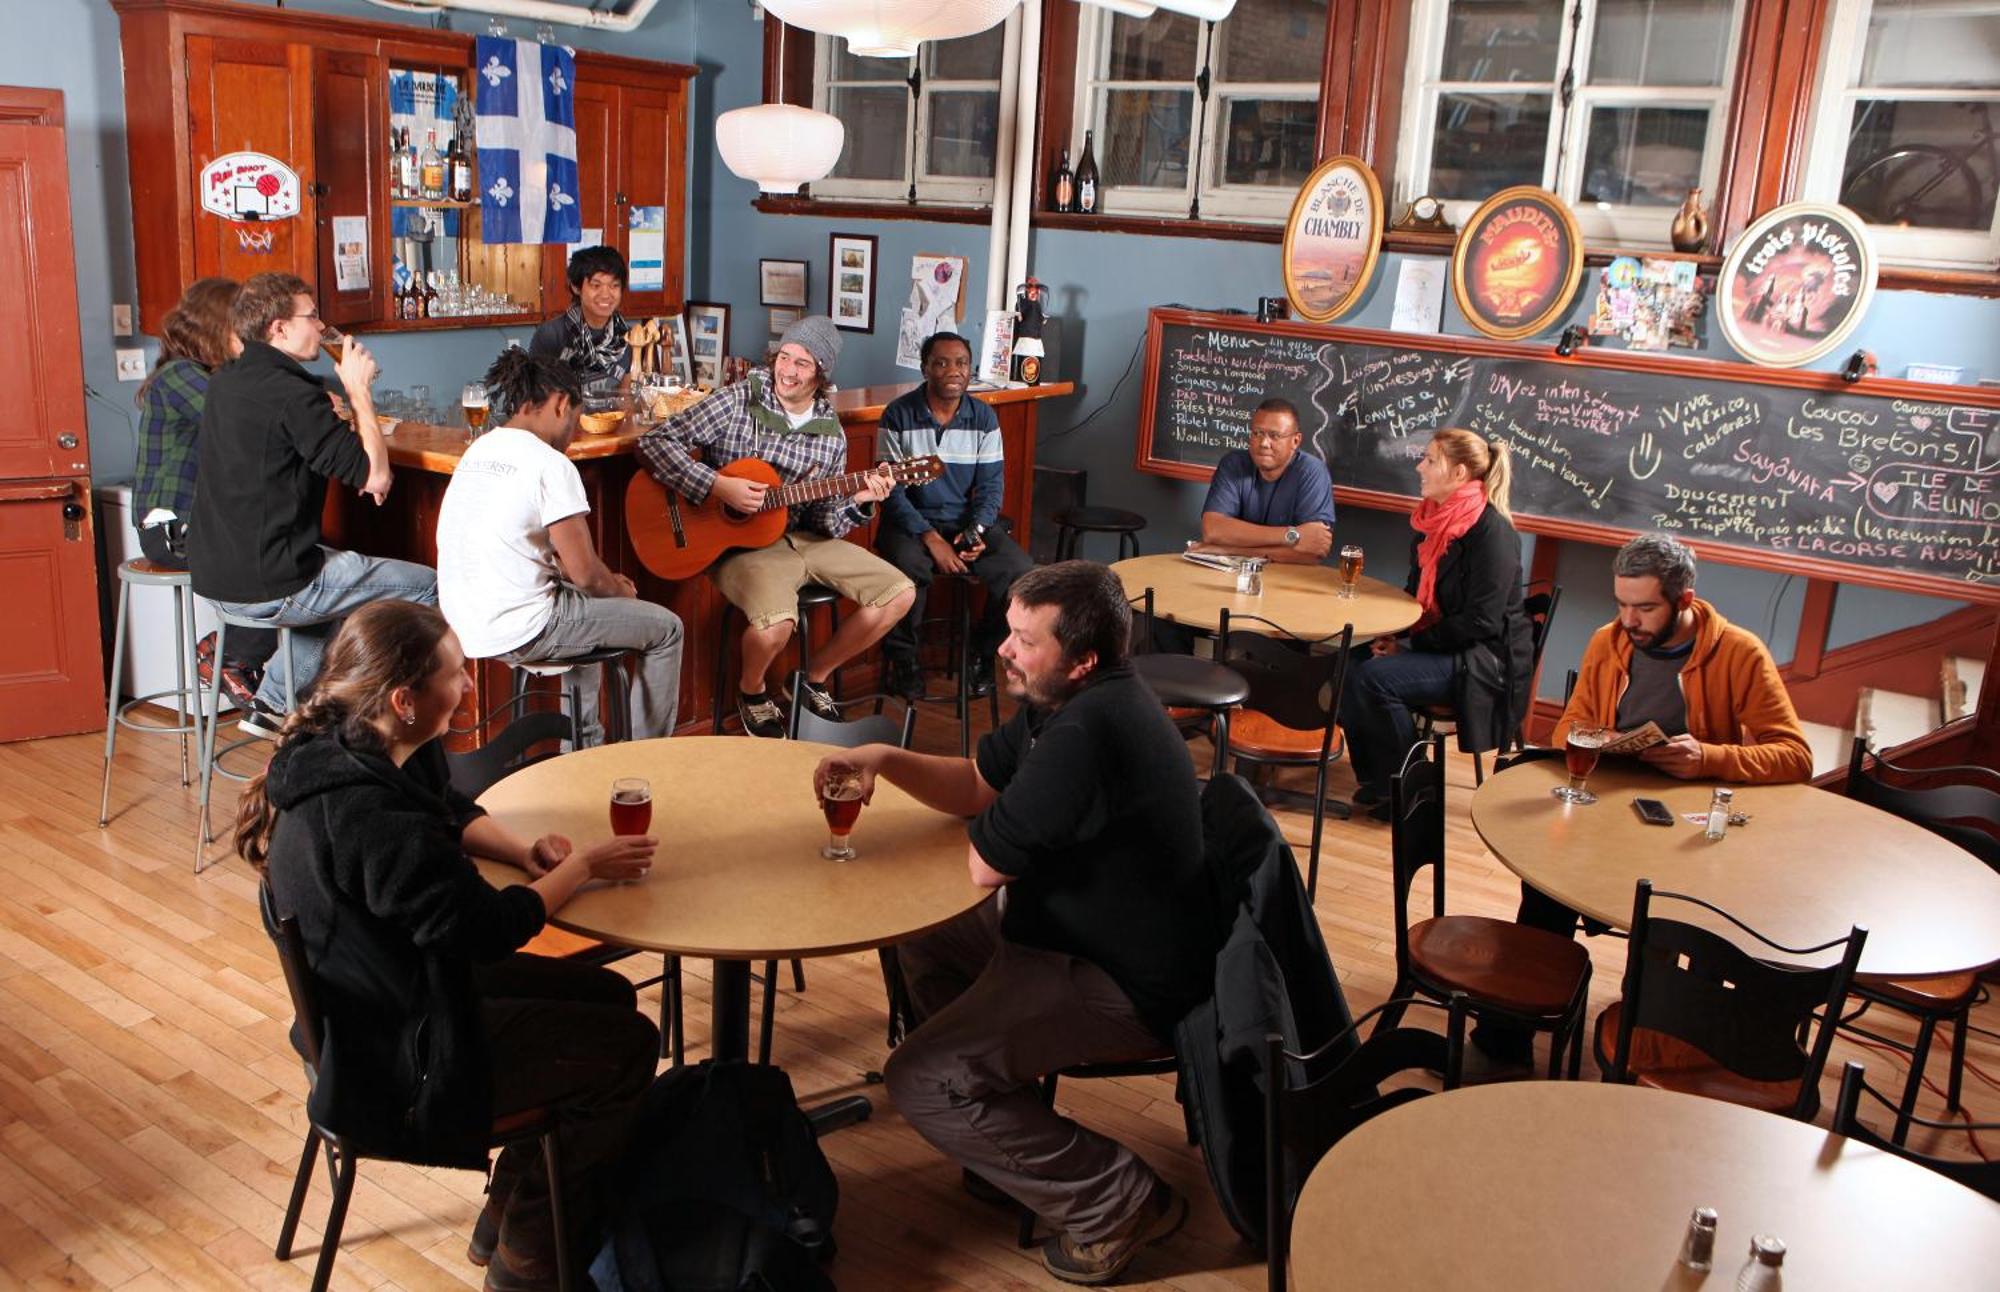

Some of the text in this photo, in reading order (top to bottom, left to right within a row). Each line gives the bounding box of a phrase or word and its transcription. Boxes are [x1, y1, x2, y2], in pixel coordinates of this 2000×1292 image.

[1310, 176, 1364, 215] BLANCHE DE
[1304, 217, 1363, 240] CHAMBLY
[1802, 398, 1880, 426] Coucou
